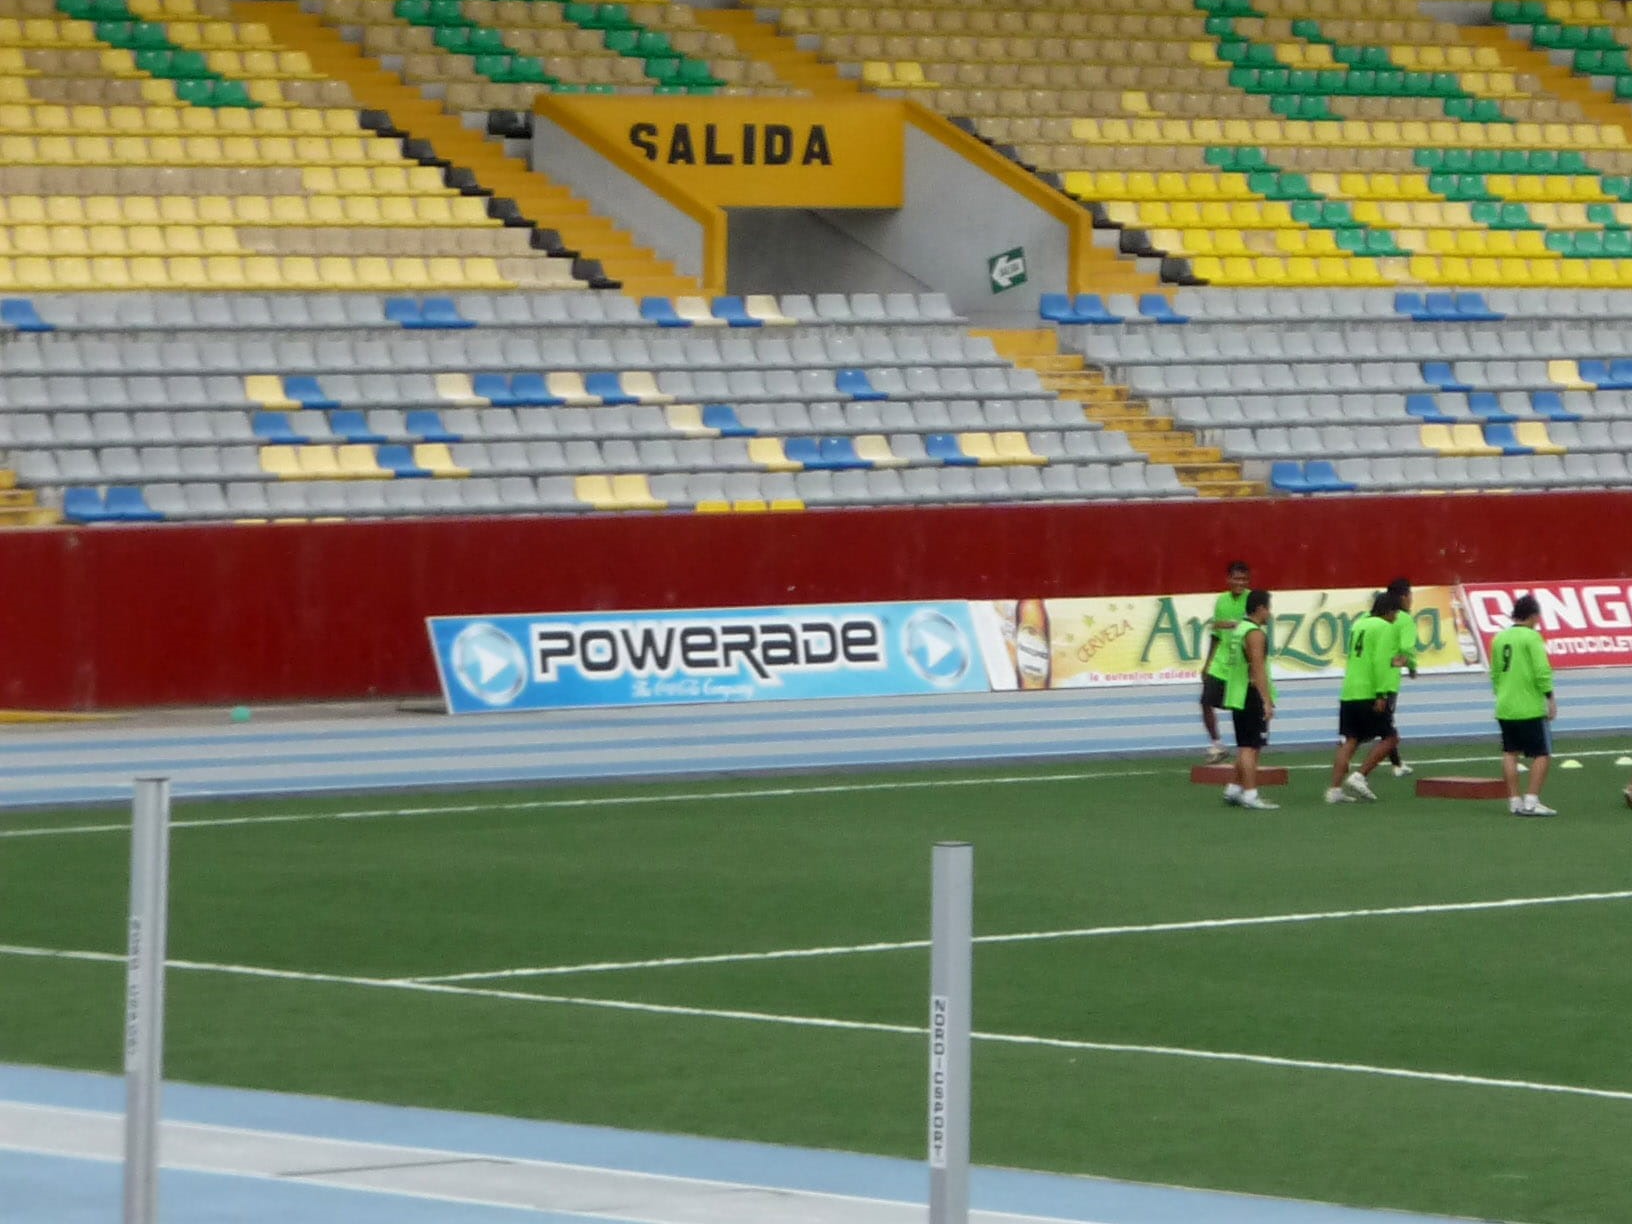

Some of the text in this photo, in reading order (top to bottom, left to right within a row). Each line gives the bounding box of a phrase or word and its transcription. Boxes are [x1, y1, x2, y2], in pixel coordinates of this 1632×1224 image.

[629, 122, 833, 165] SALIDA
[1077, 618, 1134, 664] CERVEZA
[1502, 642, 1513, 672] 9
